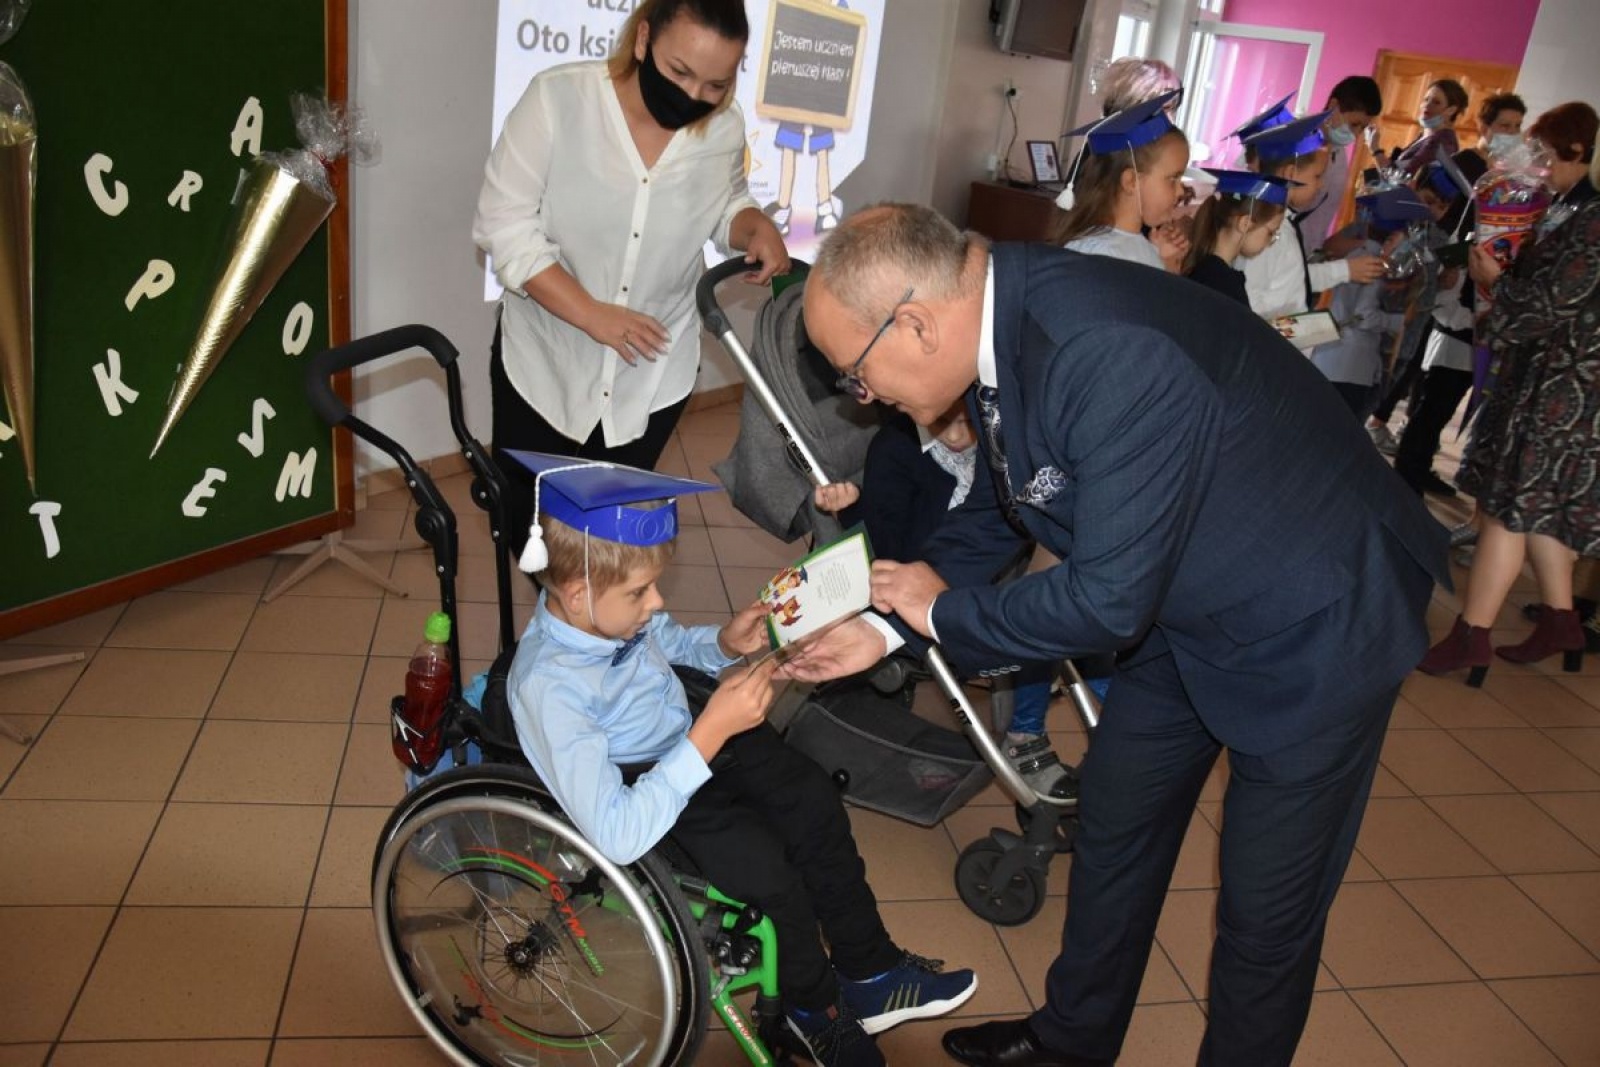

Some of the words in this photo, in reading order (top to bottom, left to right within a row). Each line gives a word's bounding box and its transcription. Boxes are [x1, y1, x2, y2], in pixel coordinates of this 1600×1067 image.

[517, 19, 569, 53] Oto
[773, 30, 812, 52] Jestem
[230, 96, 264, 157] A
[83, 151, 129, 218] C
[167, 169, 204, 213] R
[124, 259, 176, 312] P
[282, 301, 313, 356] O
[91, 347, 139, 417] K
[181, 467, 227, 518] E
[275, 446, 317, 503] M
[28, 500, 63, 560] T
[550, 881, 586, 936] GTM
